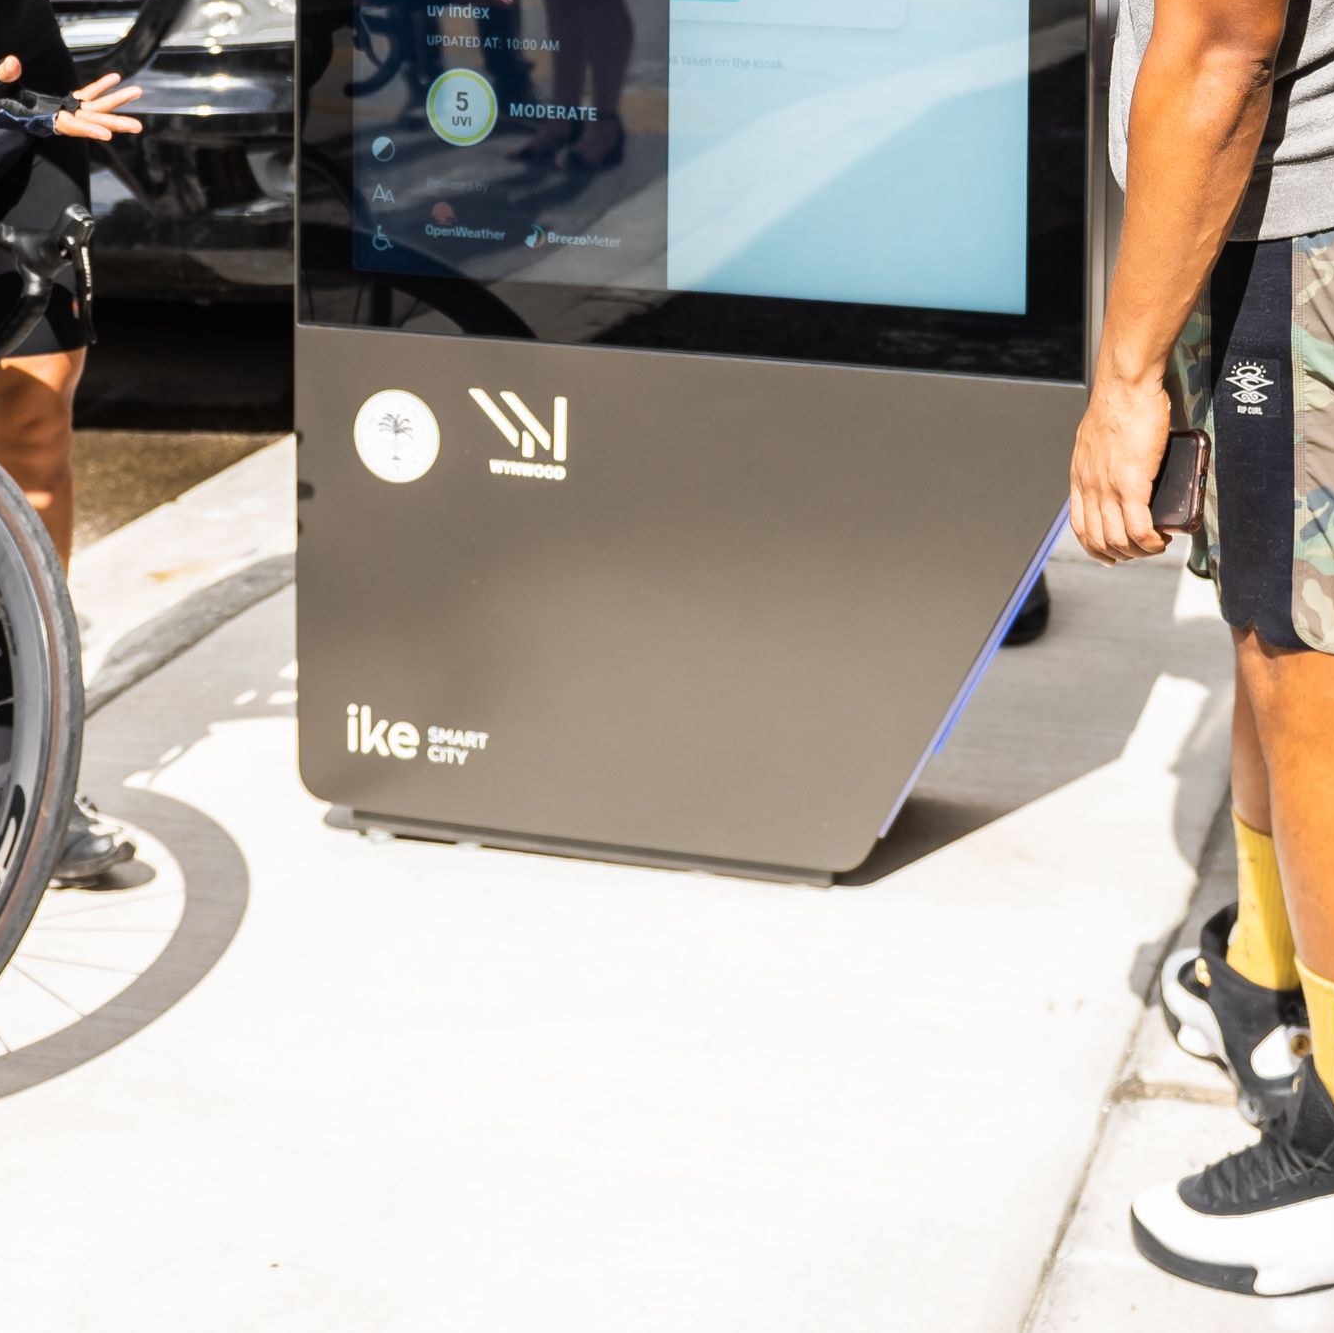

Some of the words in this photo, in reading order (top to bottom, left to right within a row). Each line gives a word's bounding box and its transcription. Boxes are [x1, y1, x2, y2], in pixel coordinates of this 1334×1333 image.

[427, 5, 444, 17] uv
[448, 3, 490, 20] index
[427, 35, 481, 48] UPDATED
[484, 36, 503, 49] AT:
[507, 38, 537, 51] 10:00
[540, 39, 560, 52] AM
[681, 55, 713, 67] taken
[715, 57, 729, 67] on
[732, 57, 750, 69] the
[455, 91, 469, 111] 5
[451, 116, 472, 127] UVI
[509, 103, 598, 122] MODERATE
[474, 179, 489, 194] by
[425, 223, 507, 242] OpenWeather
[547, 231, 622, 249] BreezoMeter
[489, 458, 567, 481] WYNWOOD
[345, 702, 422, 761] ike
[426, 724, 489, 750] SMART
[426, 744, 470, 767] CITY
